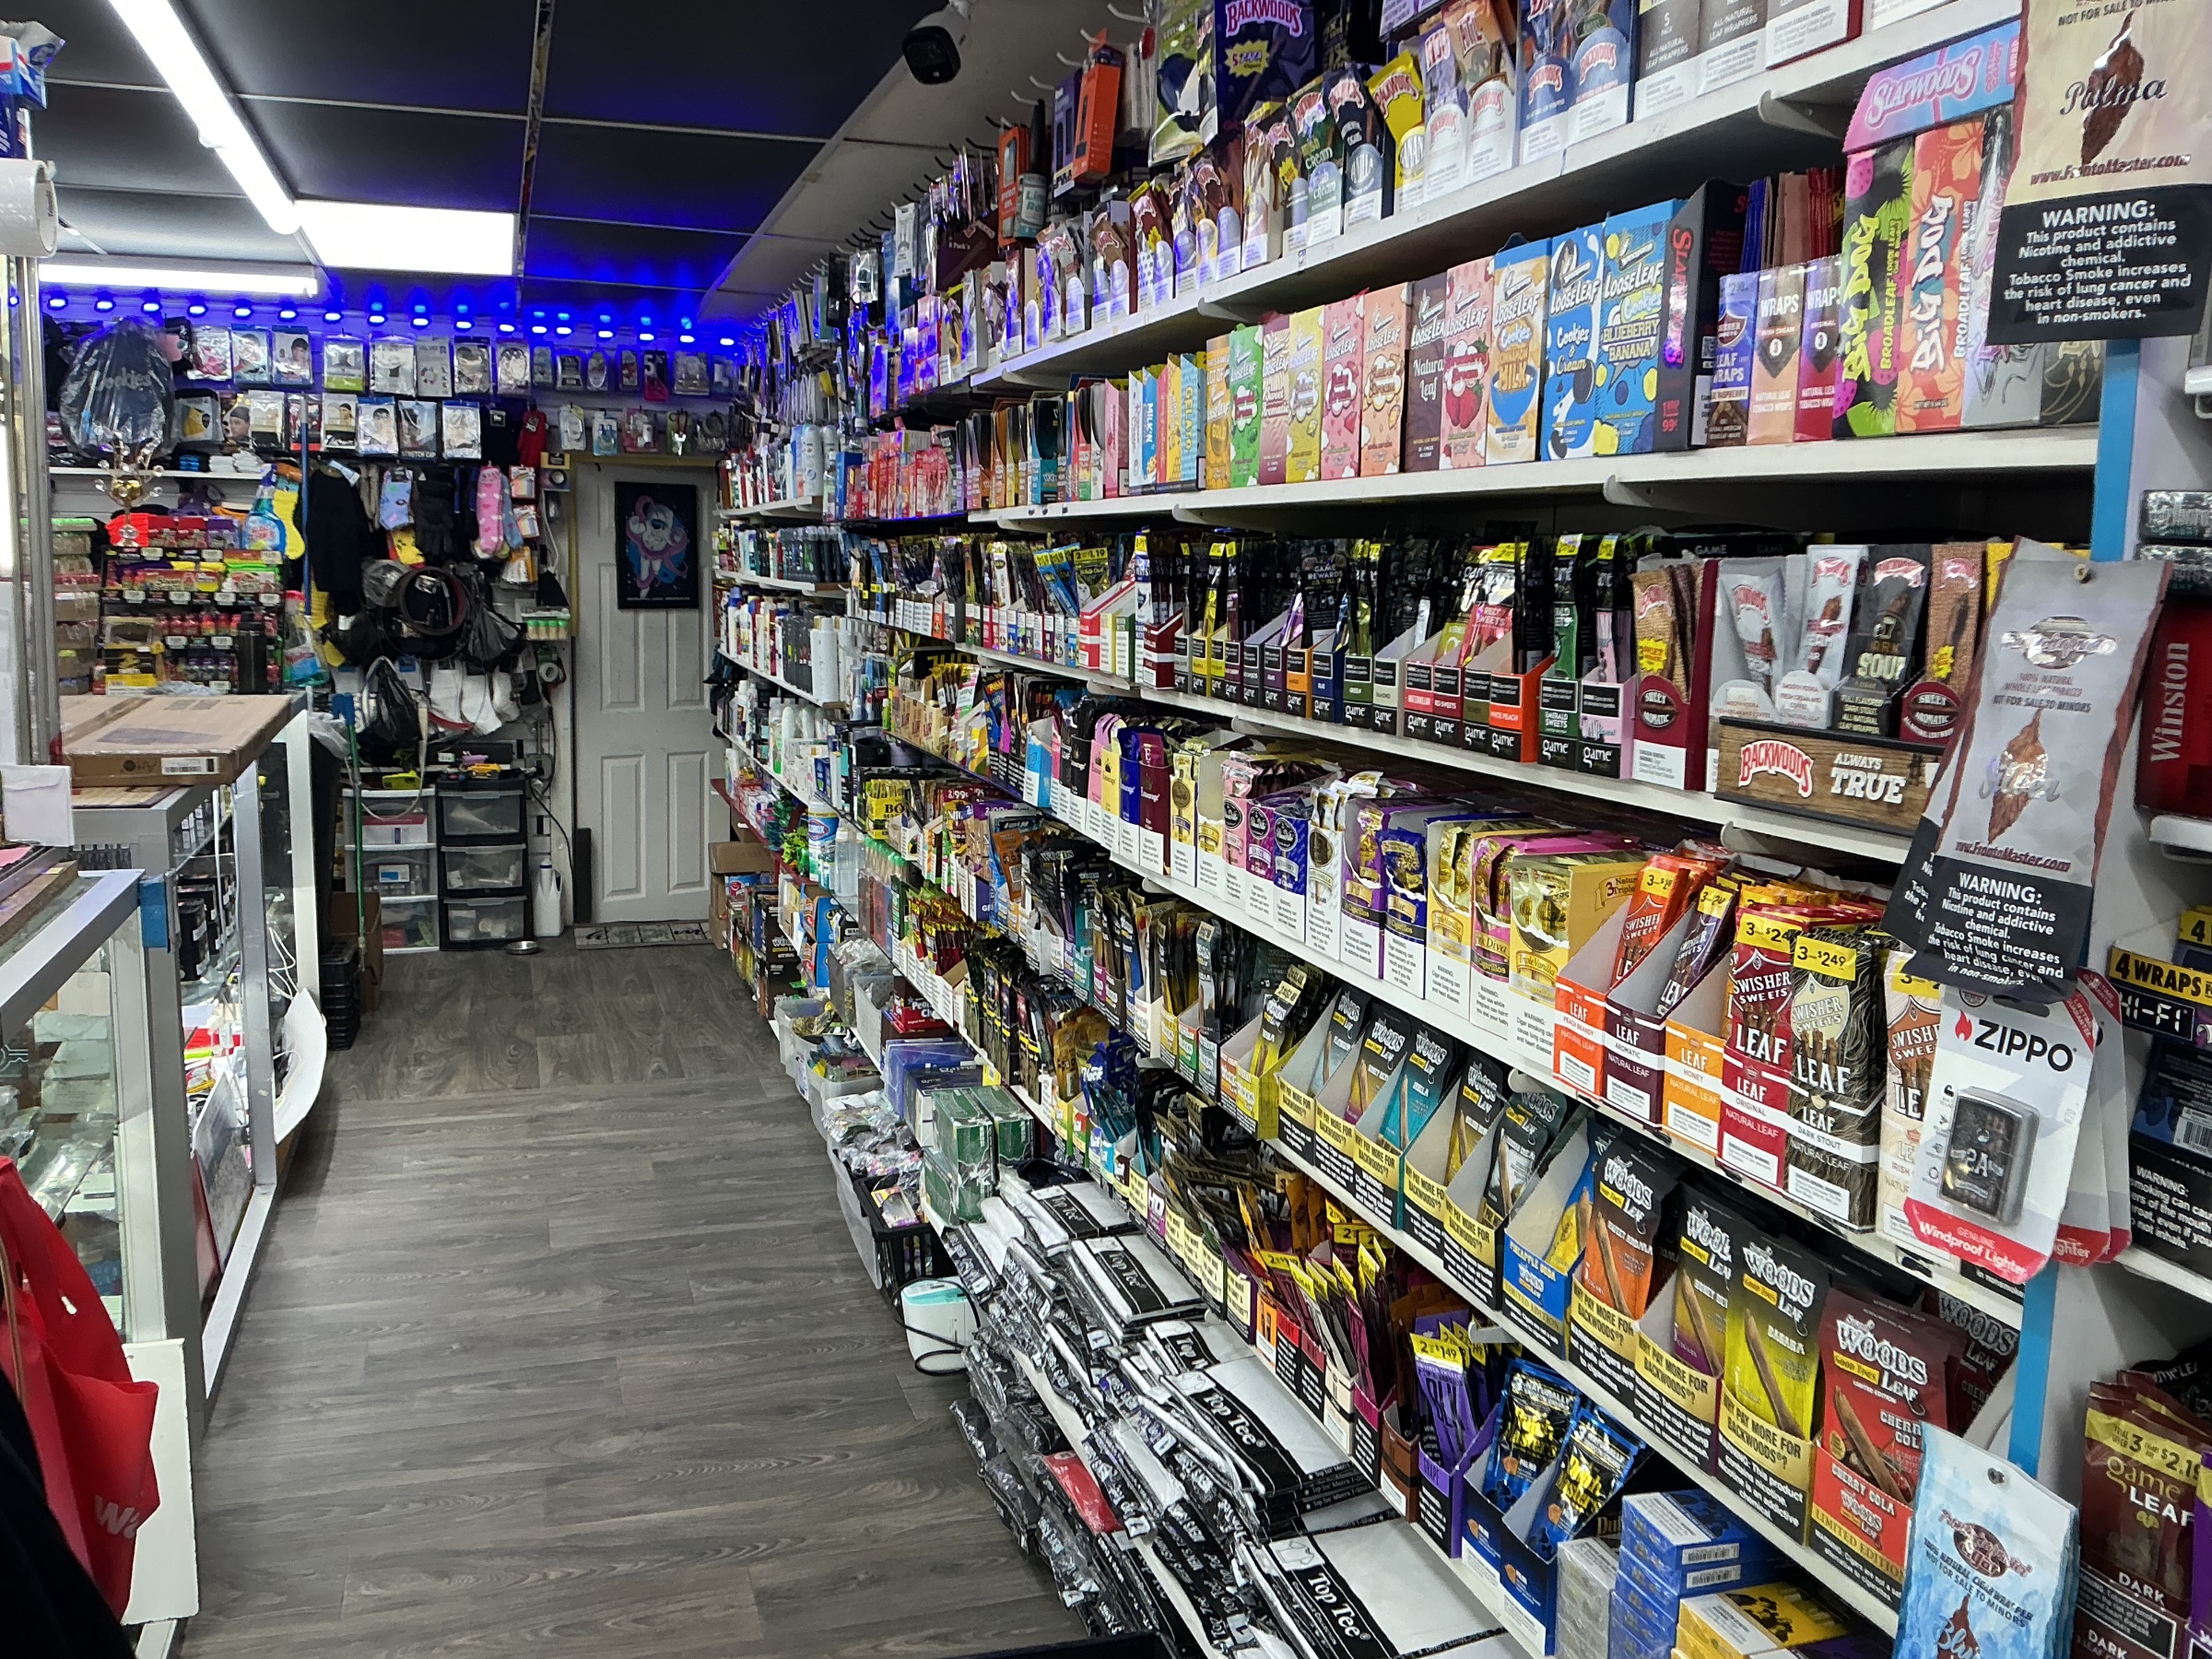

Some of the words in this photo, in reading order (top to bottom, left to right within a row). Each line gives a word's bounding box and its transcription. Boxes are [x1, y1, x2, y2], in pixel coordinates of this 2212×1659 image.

[2058, 12, 2077, 27] NOT
[2081, 8, 2100, 21] FOR
[2103, 2, 2127, 17] SALE
[1866, 49, 1979, 126] SLAPWOODS
[2059, 78, 2168, 116] Palma
[2042, 199, 2156, 229] WARNING:
[2027, 230, 2050, 244] This
[2053, 224, 2107, 247] product
[2111, 218, 2176, 236] contains
[2018, 242, 2071, 259] Nicotine
[2075, 237, 2101, 253] and
[2106, 233, 2177, 251] addictive
[2060, 251, 2126, 268] chemical.
[2003, 288, 2024, 300] the
[2028, 284, 2053, 298] risk
[2057, 282, 2073, 296] of
[2076, 279, 2106, 297] lung
[2109, 279, 2158, 291] cancer
[2160, 274, 2193, 288] and
[2009, 272, 2062, 287] Tobacco
[2065, 266, 2113, 281] Smoke
[2117, 262, 2187, 277] increases
[1760, 294, 1799, 318] WRAPS
[1954, 259, 1972, 359] BROADLEAF
[2025, 297, 2063, 312] heart
[2065, 293, 2121, 309] disease,
[2124, 292, 2161, 305] even
[1880, 276, 1897, 370] BROADLEAF
[2037, 311, 2050, 324] in
[2053, 307, 2147, 324] non-smokers.
[1557, 324, 1590, 348] Cookies
[1604, 321, 1659, 343] BLUEBERRY
[1608, 340, 1652, 362] BANANA
[1499, 360, 1528, 391] MILK
[1557, 359, 1587, 376] Cream
[1419, 377, 1438, 402] Leaf
[2151, 641, 2190, 763] Winston
[1738, 739, 1814, 798] BACKWOODS
[1834, 752, 1883, 772] ALWAYS
[1830, 766, 1907, 805] TRUE
[1959, 872, 2042, 904] WARNING:
[1941, 898, 1974, 917] Nicotine
[1977, 909, 1995, 922] and
[1997, 913, 2054, 935] addictive
[1948, 887, 1961, 900] This
[1962, 892, 2001, 911] product
[2003, 903, 2056, 922] contains
[1746, 922, 1755, 936] 3
[1965, 920, 2011, 939] chemical.
[1797, 946, 1808, 961] 3
[1935, 922, 1965, 940] Tobacco
[1967, 934, 2000, 949] Smoke
[2003, 941, 2061, 965] increases
[1943, 948, 1971, 966] heart
[1734, 971, 1792, 995] SWISHER
[2037, 964, 2064, 979] and
[2115, 952, 2130, 979] 4
[2133, 960, 2202, 998] WRAPS
[1739, 986, 1788, 1006] SWEETS
[1792, 995, 1844, 1021] SWISHER
[1571, 1002, 1589, 1021] LEAF
[1797, 1014, 1841, 1032] SWEETS
[1616, 1024, 1641, 1047] LEAF
[1735, 1024, 1788, 1065] LEAF
[1974, 1018, 2074, 1073] ZIPPO
[1615, 1041, 1641, 1059] AROMATIC
[1681, 1047, 1708, 1071] LEAF
[1607, 1053, 1632, 1073] NATURAL
[1632, 1063, 1650, 1078] LEAF
[1684, 1068, 1704, 1084] HONEY
[1796, 1053, 1851, 1095] LEAF
[1669, 1077, 1699, 1100] NATURAL
[1700, 1088, 1719, 1106] LEAF
[1736, 1077, 1768, 1103] LEAF
[1735, 1097, 1767, 1118] ORIGINAL
[1725, 1109, 1755, 1131] NATURAL
[1757, 1122, 1780, 1139] LEAF
[1803, 1107, 1836, 1135] LEAF
[1797, 1125, 1816, 1142] DARK
[1817, 1133, 1841, 1151] STOUT
[1828, 1154, 1851, 1172] LEAF
[2136, 1165, 2190, 1198] WARNING:
[1918, 1220, 1983, 1257] Windproof
[1985, 1247, 2028, 1277] Lighter
[1743, 1247, 1816, 1308] WOODS
[1836, 1319, 1929, 1385] WOODS
[1203, 1390, 1232, 1418] Top
[1735, 1405, 1750, 1428] PAY
[1751, 1415, 1779, 1443] MORE
[1780, 1434, 1803, 1460] FOR
[1879, 1409, 1922, 1436] CHERR
[2129, 1433, 2144, 1453] 3
[2106, 1455, 2183, 1503] game
[1868, 1488, 1897, 1517] COLA
[1815, 1507, 1857, 1547] LIMITED
[1308, 1571, 1338, 1606] Top
[1925, 1551, 1938, 1569] NOT
[1939, 1563, 1954, 1579] FOR
[1954, 1573, 1975, 1594] SALE
[1975, 1590, 1986, 1603] TO
[1986, 1597, 2027, 1630] MINORS
[2118, 1571, 2166, 1606] DARK
